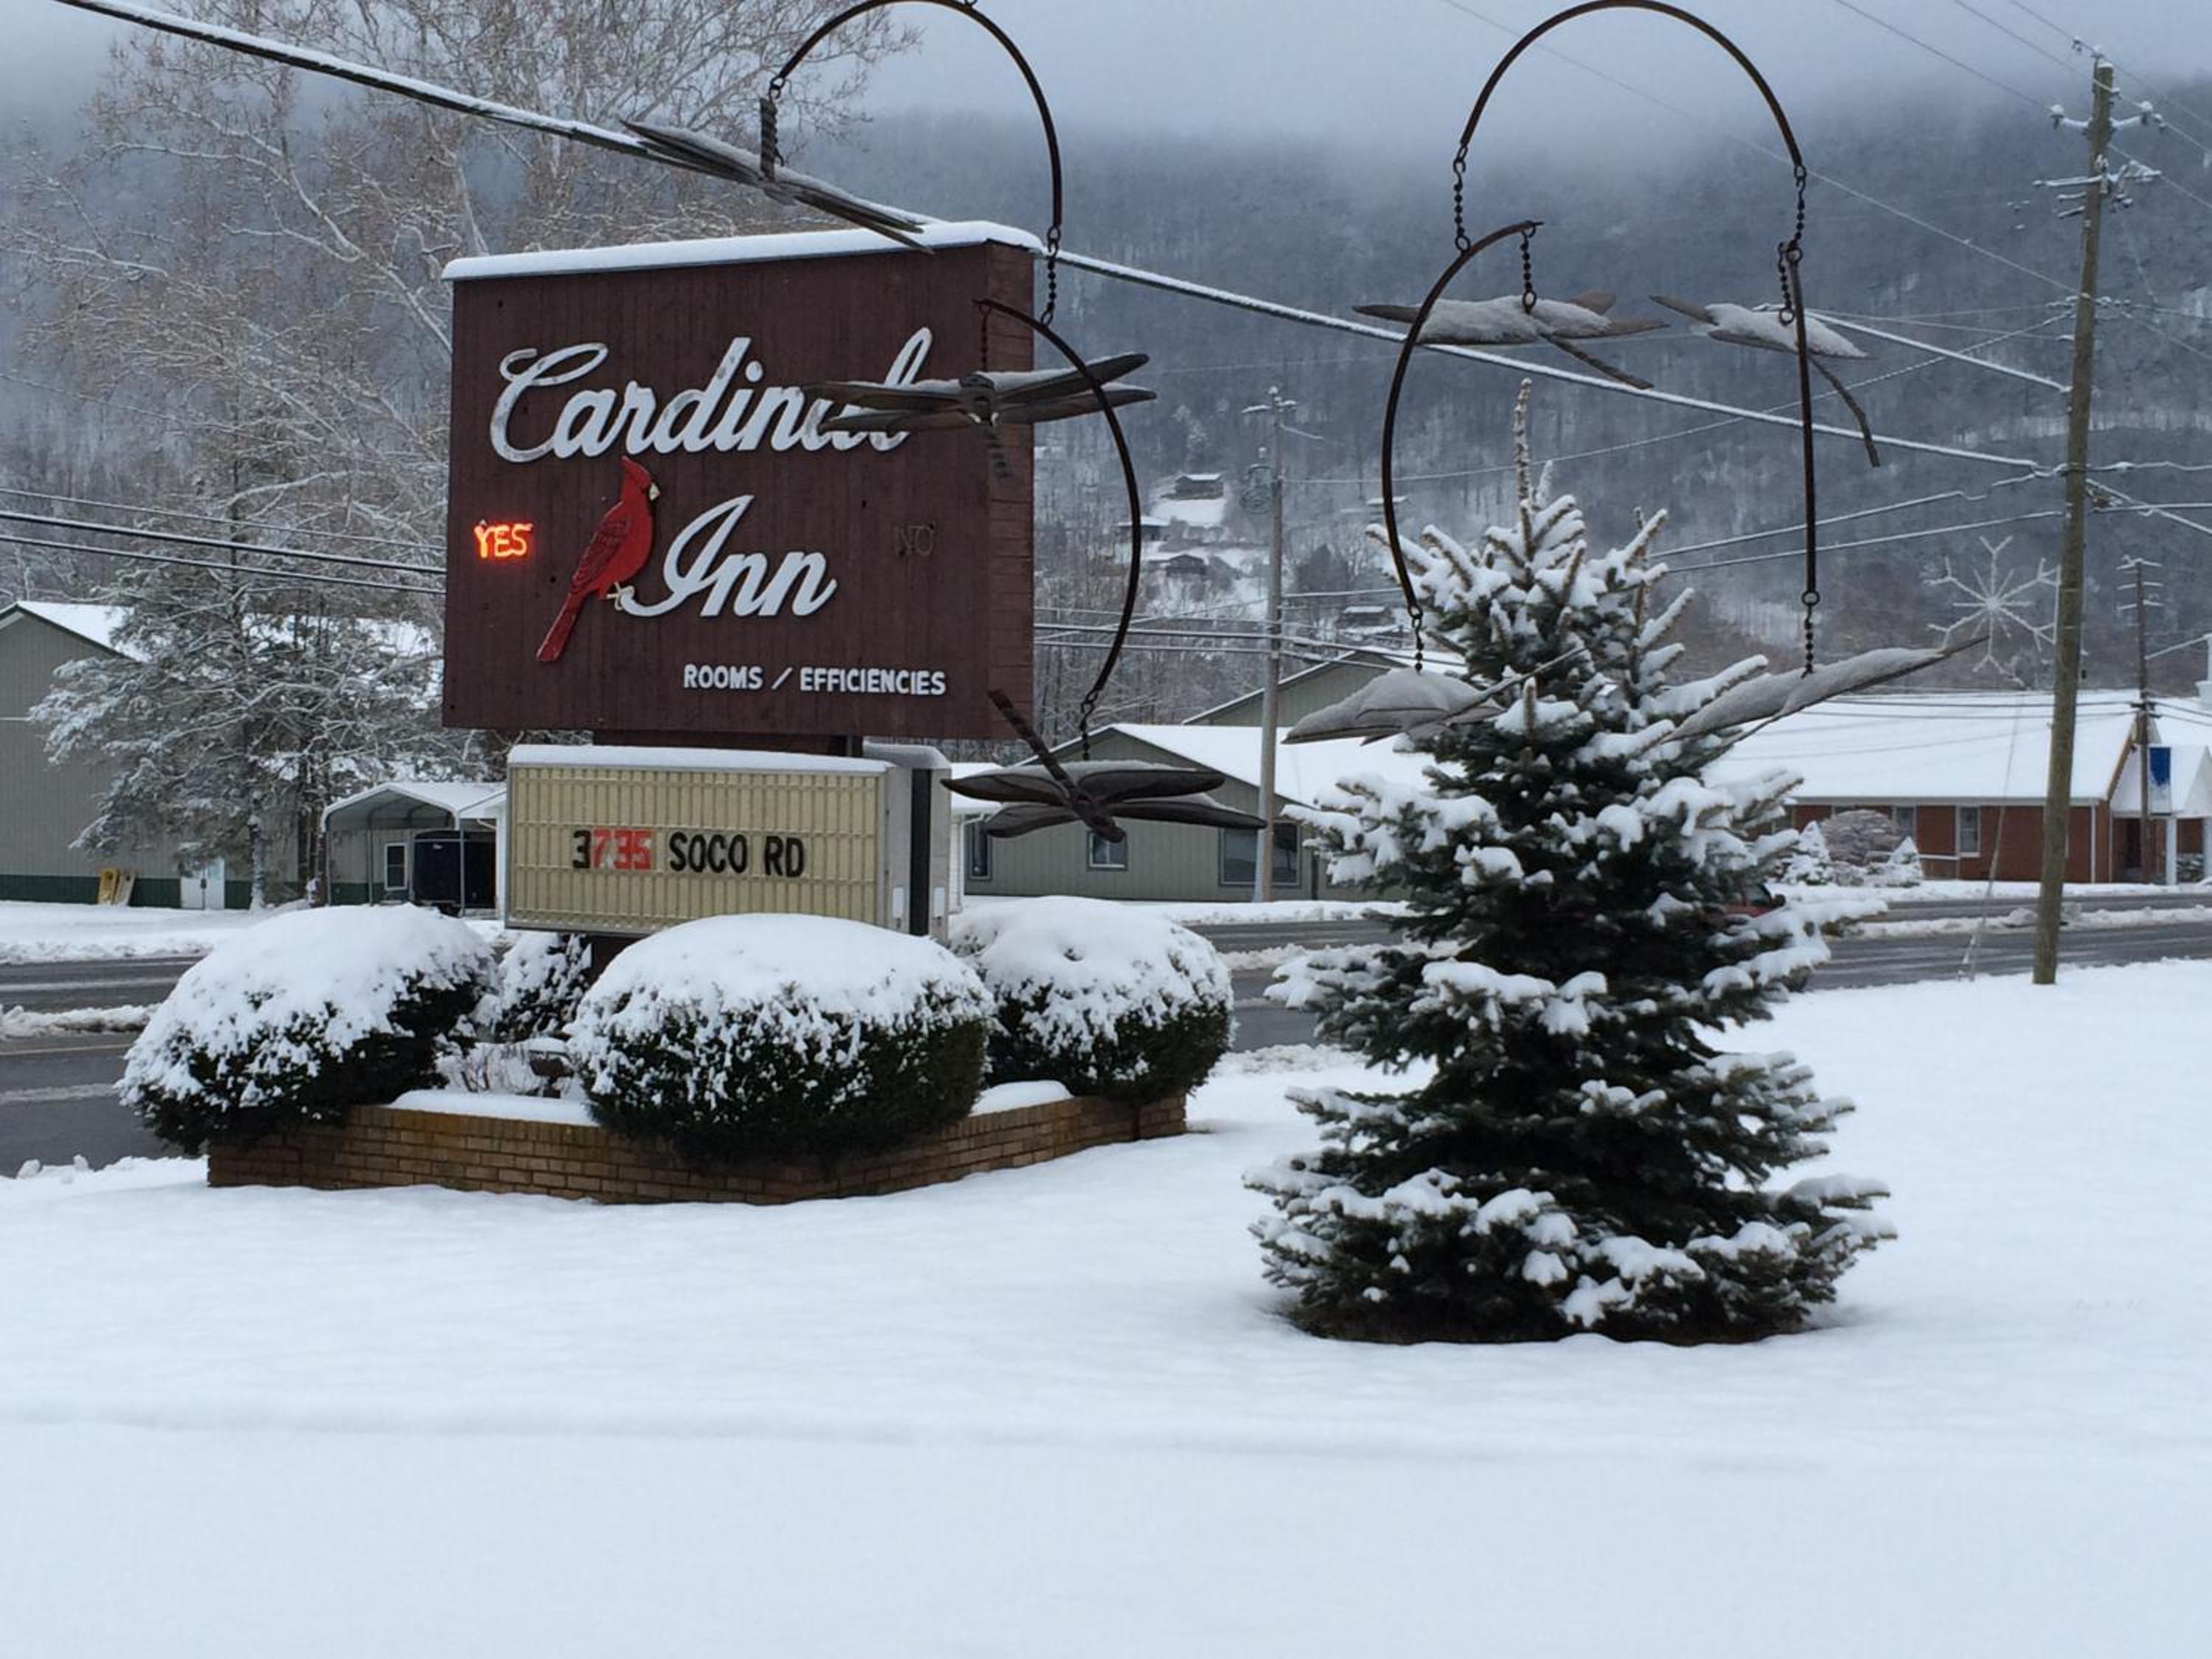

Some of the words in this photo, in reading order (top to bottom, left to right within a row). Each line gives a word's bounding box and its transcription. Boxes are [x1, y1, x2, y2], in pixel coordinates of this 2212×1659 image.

[474, 520, 532, 558] YES
[620, 495, 837, 616] Inn
[683, 664, 762, 689] ROOMS
[800, 668, 945, 695] EFFICIENCIES
[572, 829, 652, 869] 3735
[669, 832, 748, 873] SOCO
[764, 836, 805, 877] RD
